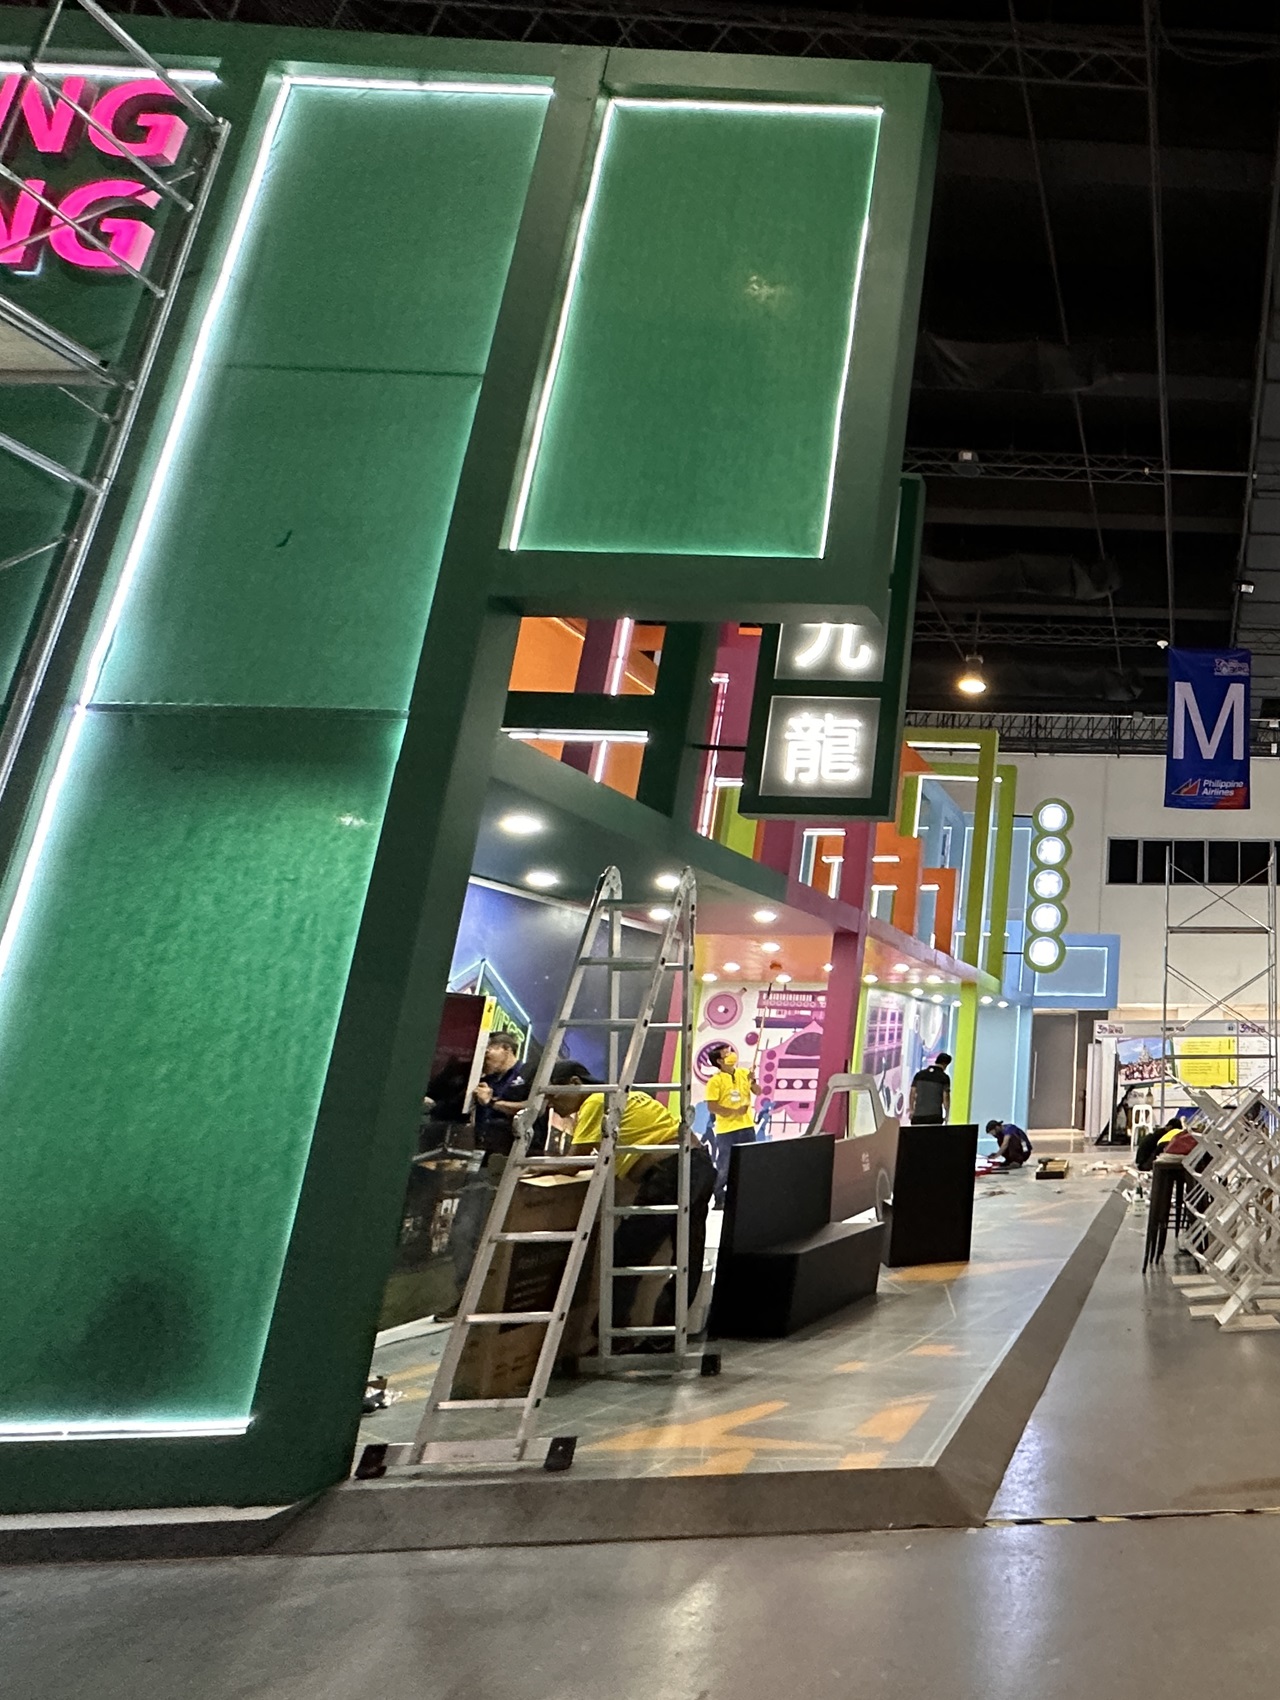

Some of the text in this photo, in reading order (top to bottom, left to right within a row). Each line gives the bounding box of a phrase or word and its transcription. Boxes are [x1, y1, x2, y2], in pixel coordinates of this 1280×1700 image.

[1172, 681, 1245, 760] M
[1203, 779, 1244, 789] Philippine
[1201, 788, 1235, 796] Airlines
